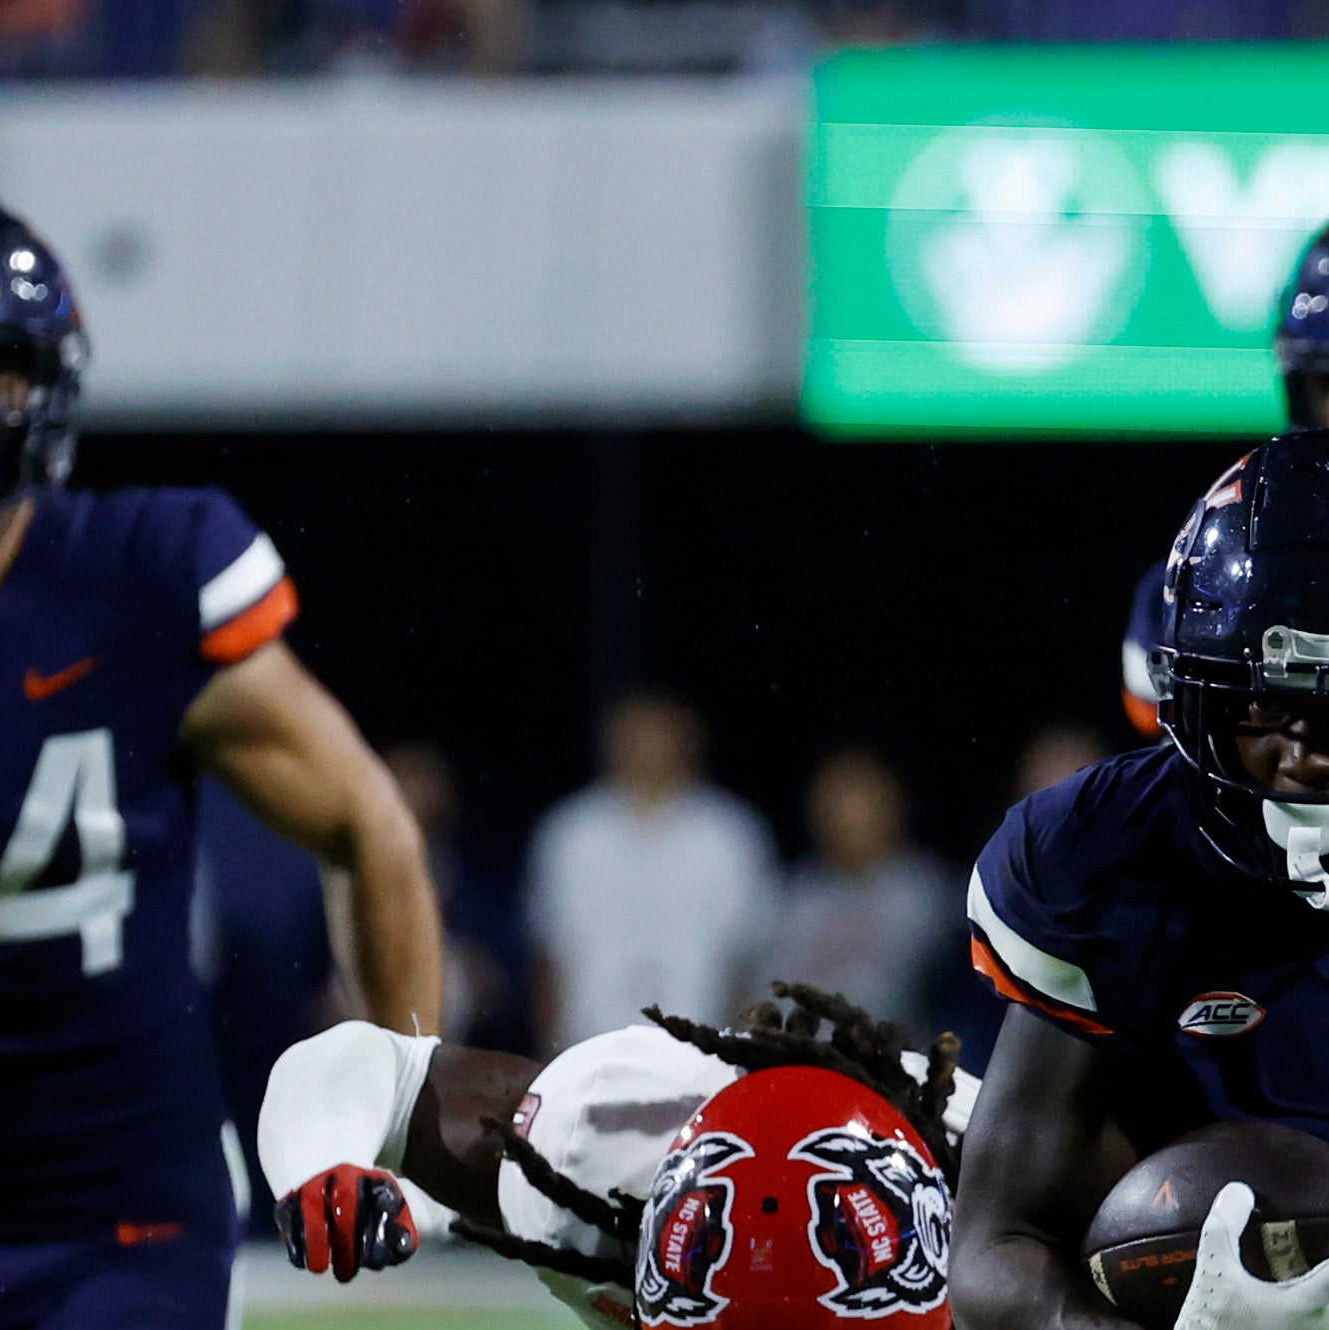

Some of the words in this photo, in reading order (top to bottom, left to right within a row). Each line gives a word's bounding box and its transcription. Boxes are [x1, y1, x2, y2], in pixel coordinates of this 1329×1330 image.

[1183, 1002, 1251, 1027] ACC
[678, 1197, 701, 1220] NC
[847, 1188, 886, 1236] STATE
[664, 1223, 687, 1273] STATE
[871, 1238, 894, 1264] NC
